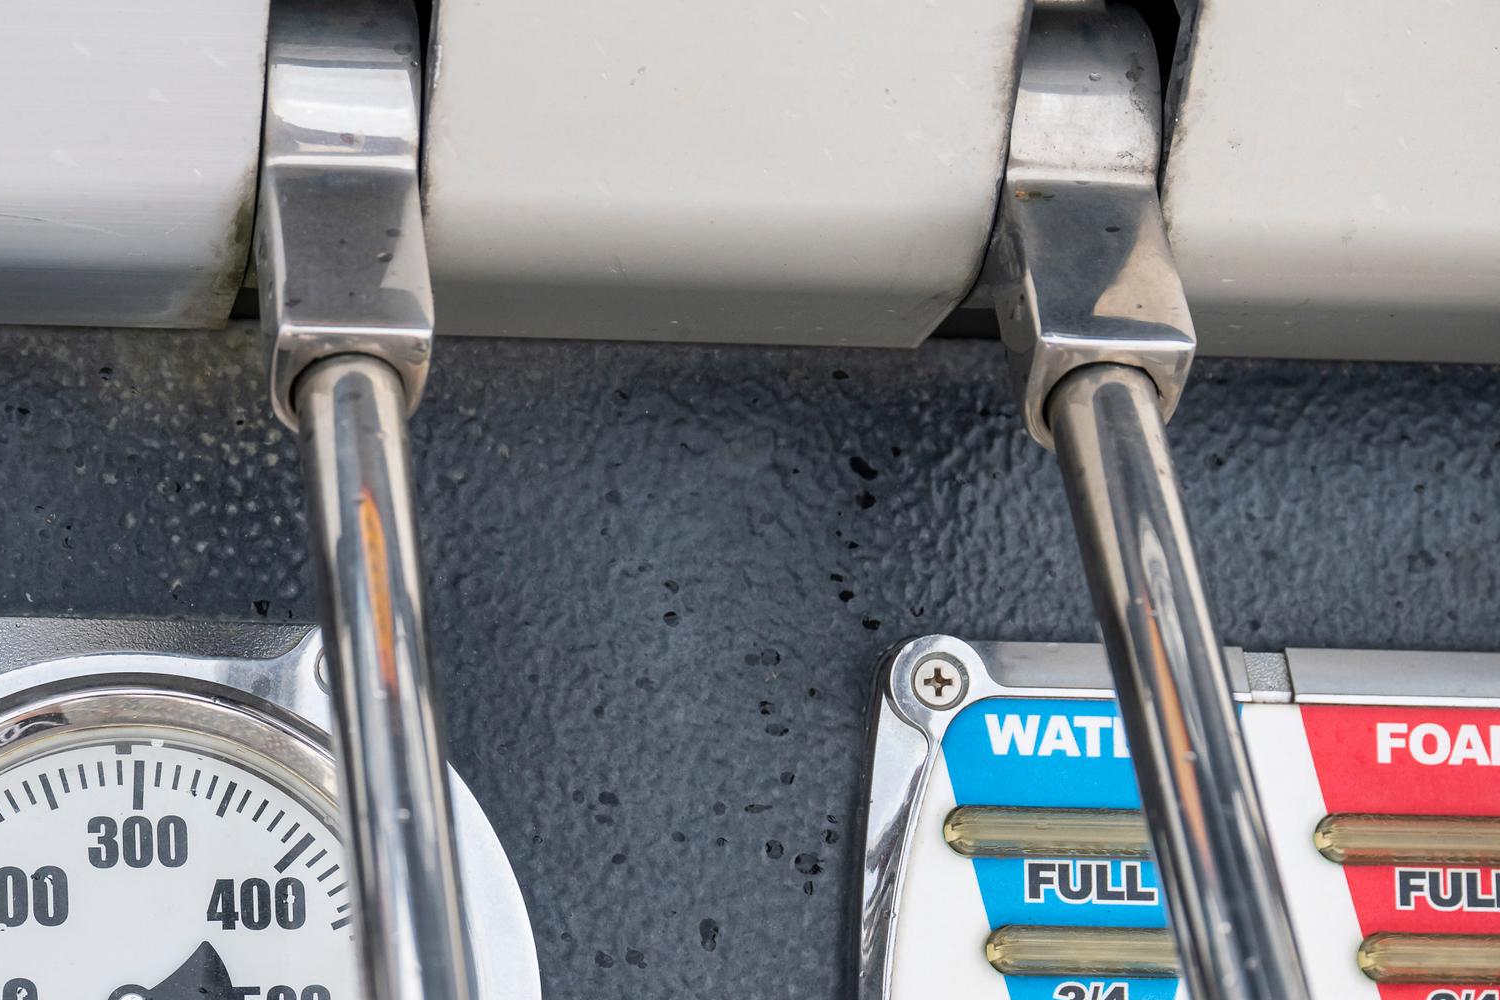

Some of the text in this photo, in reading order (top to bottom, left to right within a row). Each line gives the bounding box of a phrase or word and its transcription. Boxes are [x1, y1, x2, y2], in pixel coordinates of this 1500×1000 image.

[984, 713, 1131, 758] WAT
[1376, 722, 1500, 765] FOA
[88, 815, 188, 868] 300
[207, 877, 305, 930] 400
[1024, 860, 1159, 905] FULL
[1395, 867, 1500, 911] FUL
